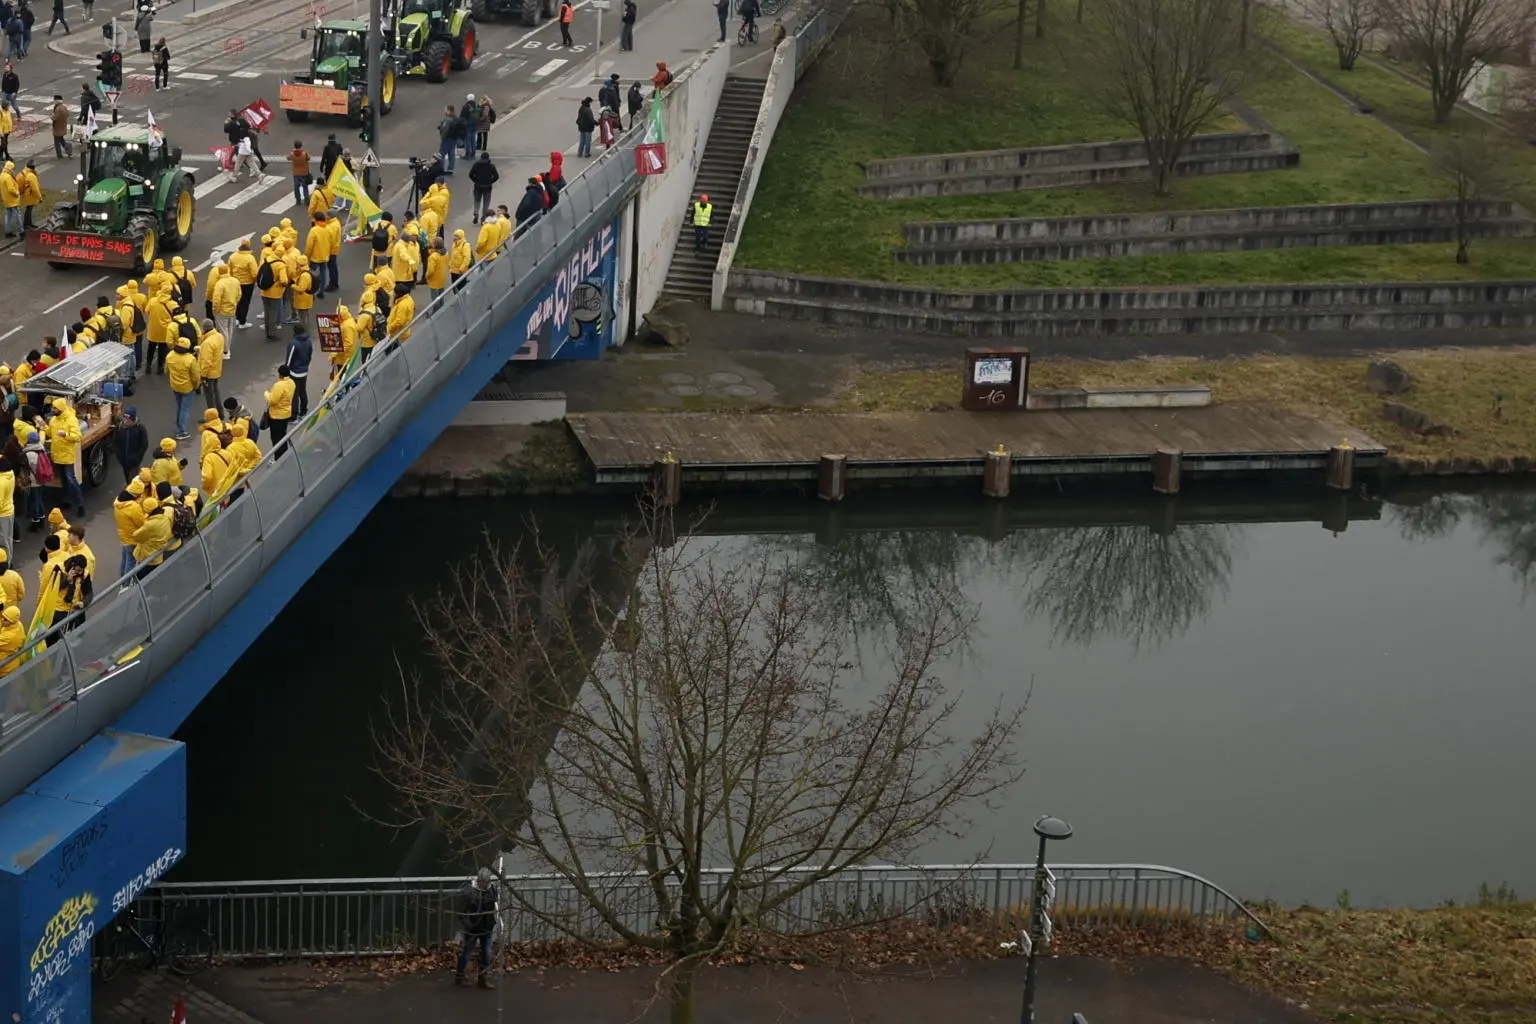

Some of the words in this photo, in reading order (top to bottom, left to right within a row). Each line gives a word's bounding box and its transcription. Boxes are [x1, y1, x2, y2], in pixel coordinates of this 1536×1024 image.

[523, 40, 587, 53] BUS
[39, 232, 61, 245] PAS
[66, 235, 80, 245] DE
[105, 240, 133, 255] SANS
[317, 317, 330, 328] NO
